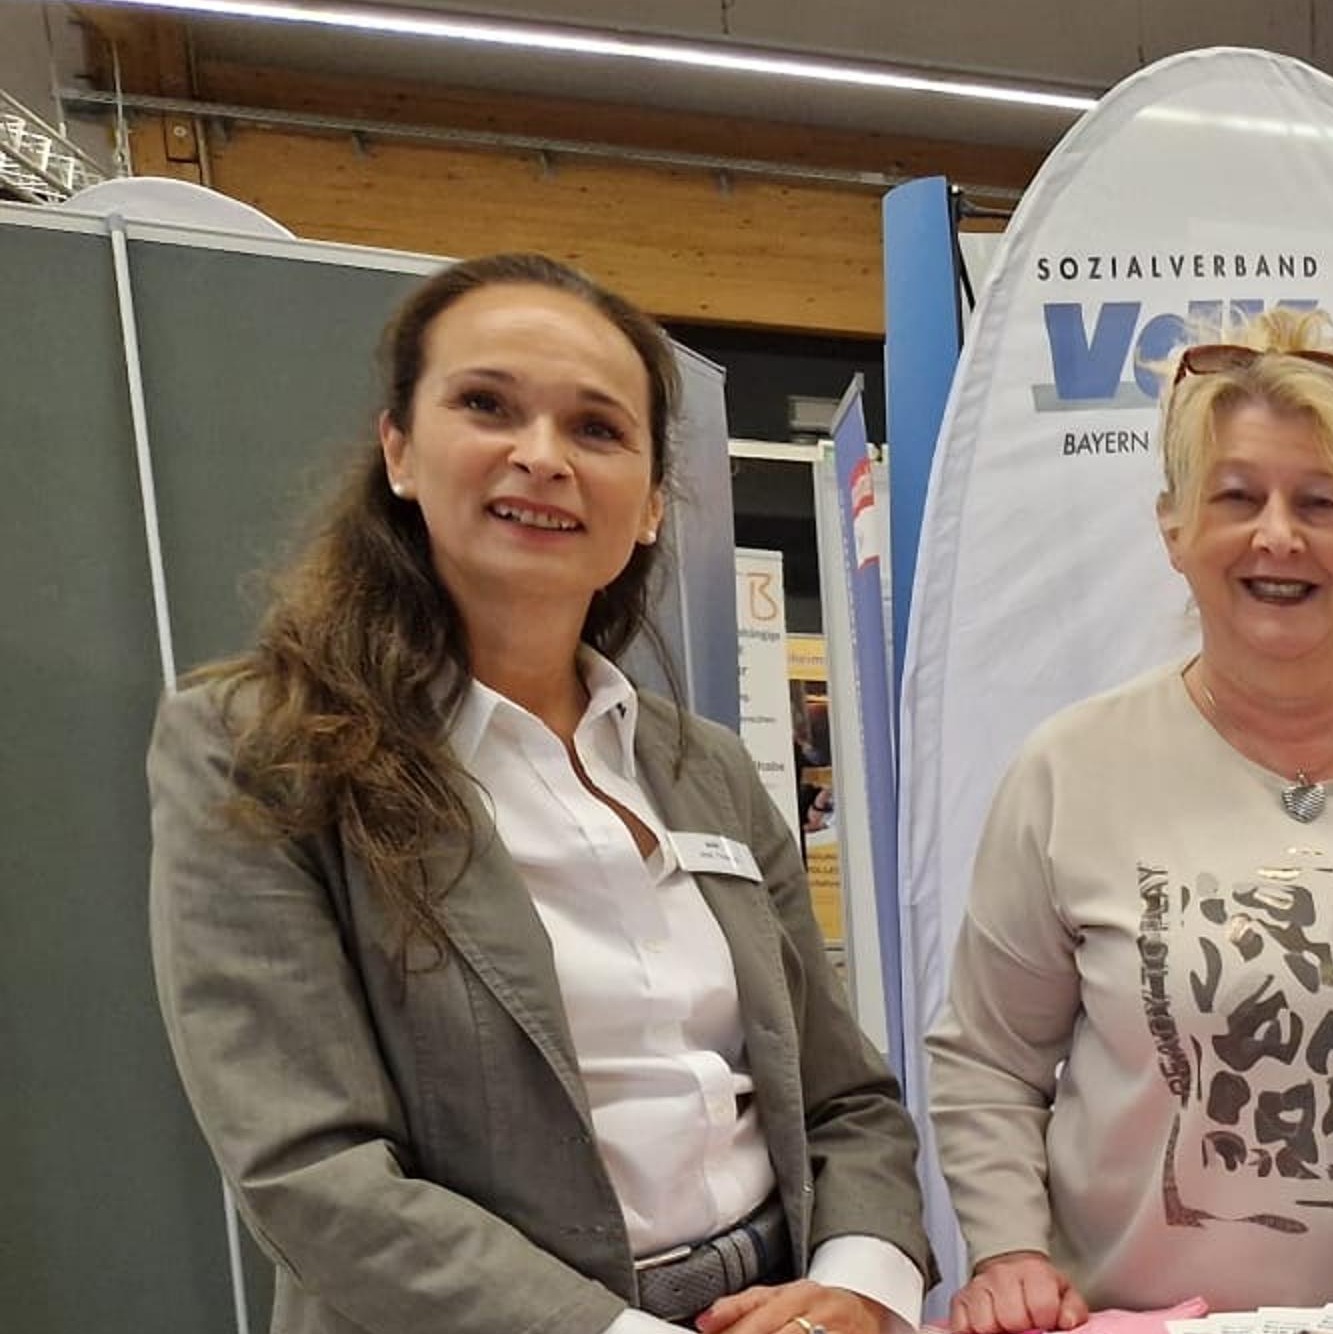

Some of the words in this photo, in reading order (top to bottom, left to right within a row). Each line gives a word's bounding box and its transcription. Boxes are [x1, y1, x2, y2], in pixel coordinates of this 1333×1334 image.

[1037, 254, 1318, 281] SOZIALVERBAND
[1043, 299, 1318, 400] Vd
[1063, 431, 1150, 456] BAYERN
